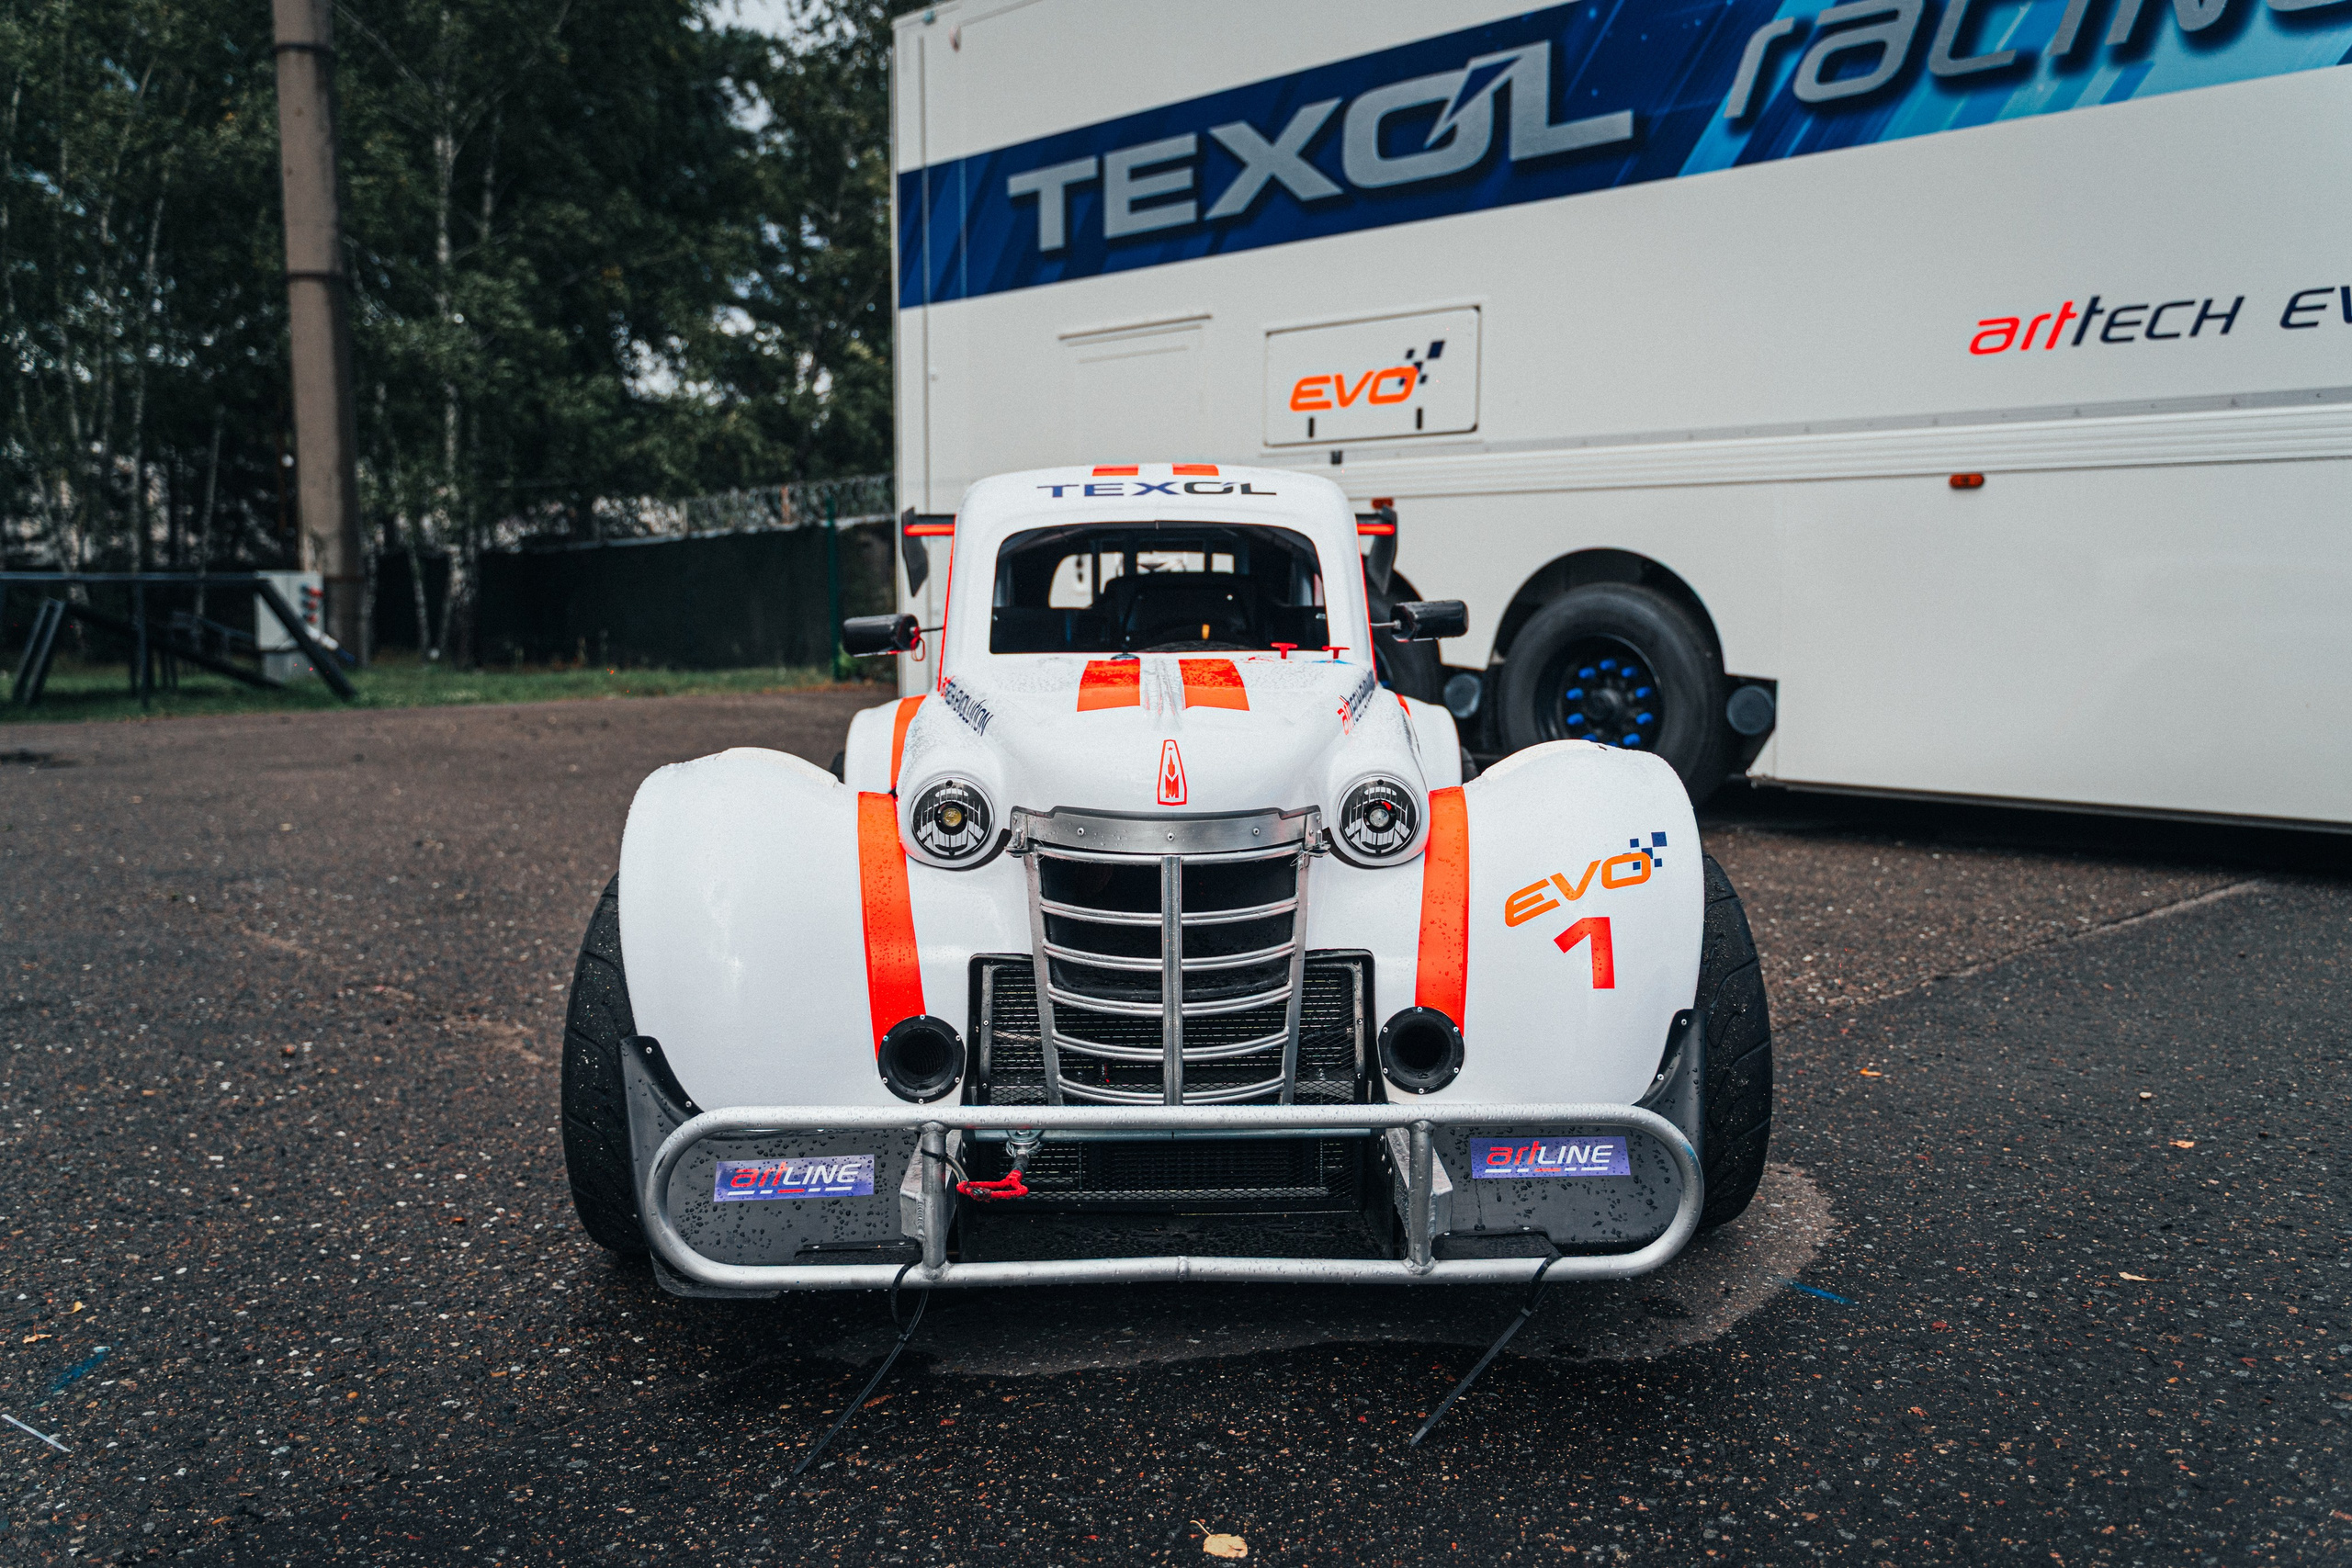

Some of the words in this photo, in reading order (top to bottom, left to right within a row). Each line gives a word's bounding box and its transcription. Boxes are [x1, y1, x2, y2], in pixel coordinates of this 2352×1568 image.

[1007, 39, 1634, 252] TEXOL
[1289, 365, 1419, 412] EVO
[1036, 480, 1277, 499] TEXOL
[1504, 852, 1652, 928] EVO
[1553, 916, 1616, 989] 1
[729, 1160, 863, 1188] artLINE
[1486, 1140, 1614, 1166] artLINE
